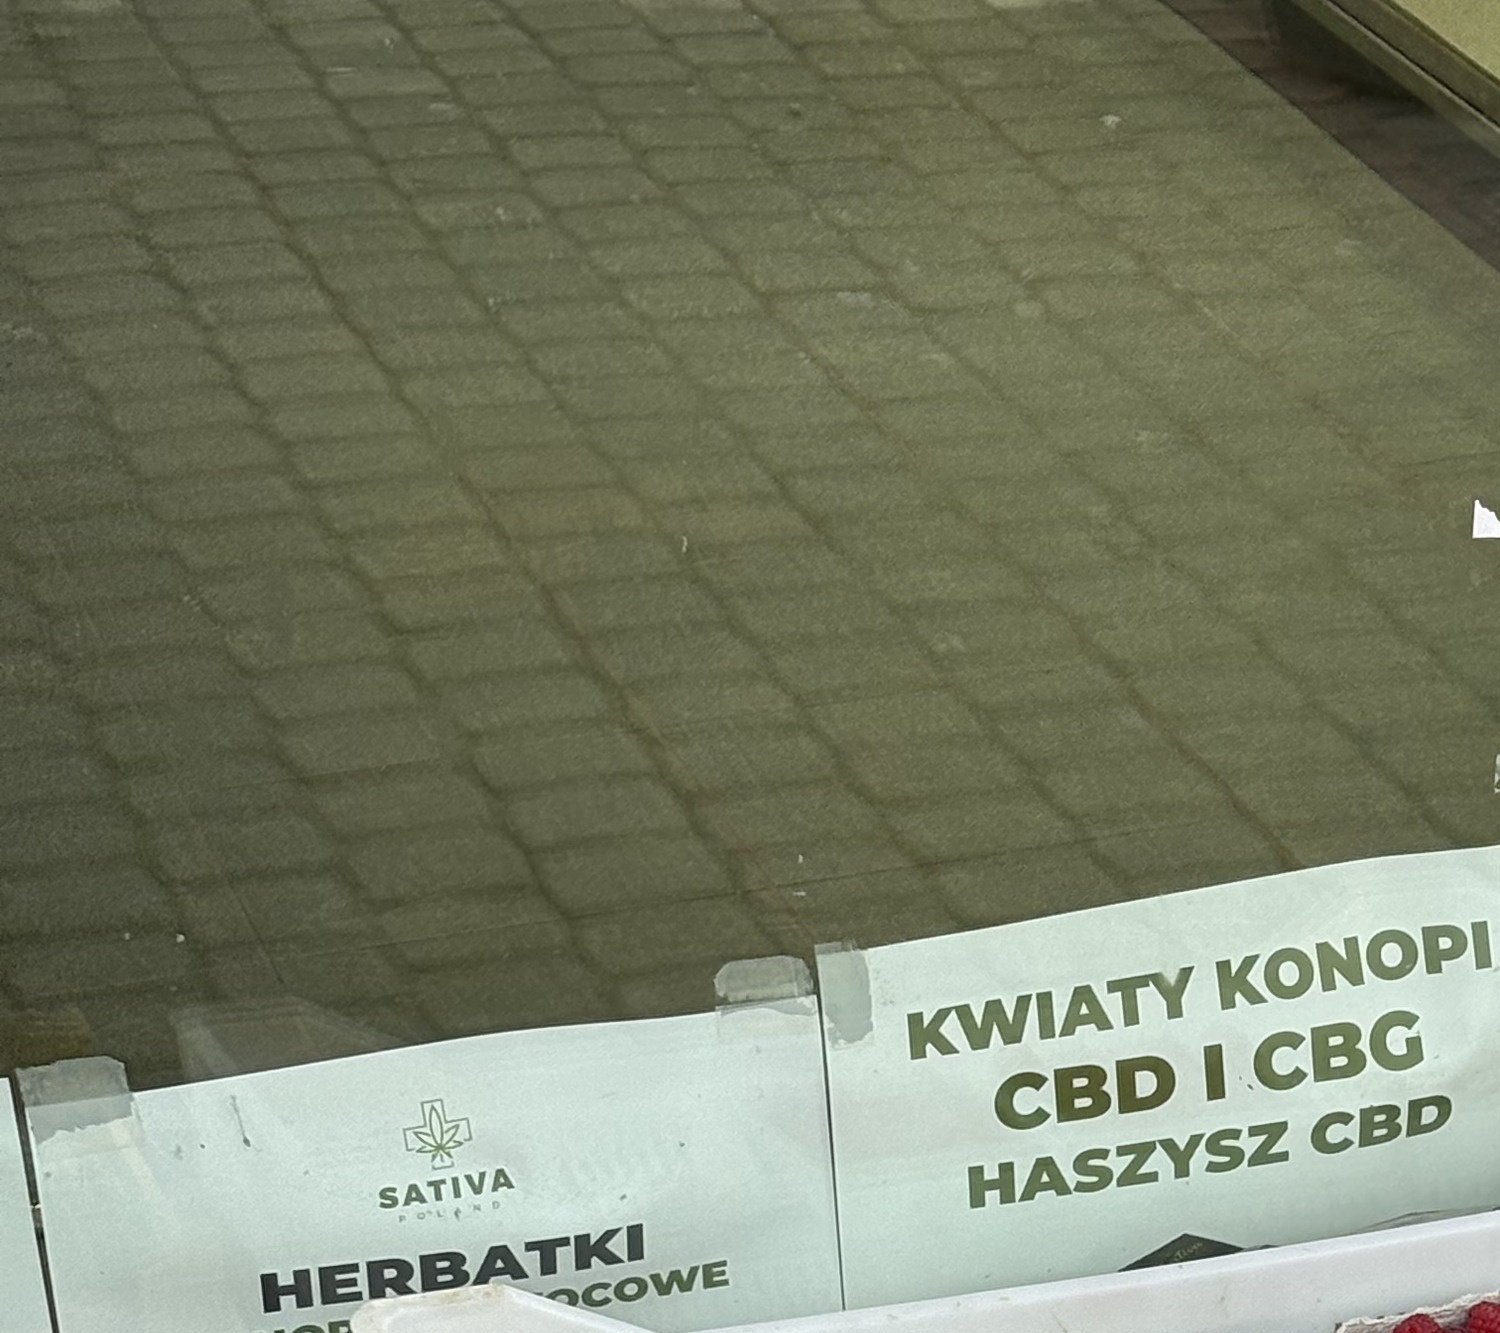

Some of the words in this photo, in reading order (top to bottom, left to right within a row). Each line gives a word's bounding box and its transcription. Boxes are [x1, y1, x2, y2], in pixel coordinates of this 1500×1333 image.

[906, 965, 1194, 1061] KWIATY
[1215, 920, 1493, 1010] KONOPI
[994, 1054, 1177, 1131] CBD
[1203, 1043, 1226, 1102] I
[1253, 1010, 1424, 1091] CBG
[378, 1168, 515, 1209] SATIVA
[967, 1121, 1289, 1210] HASZYSZ
[1309, 1094, 1453, 1155] CBD
[259, 1223, 645, 1314] HERBATKI
